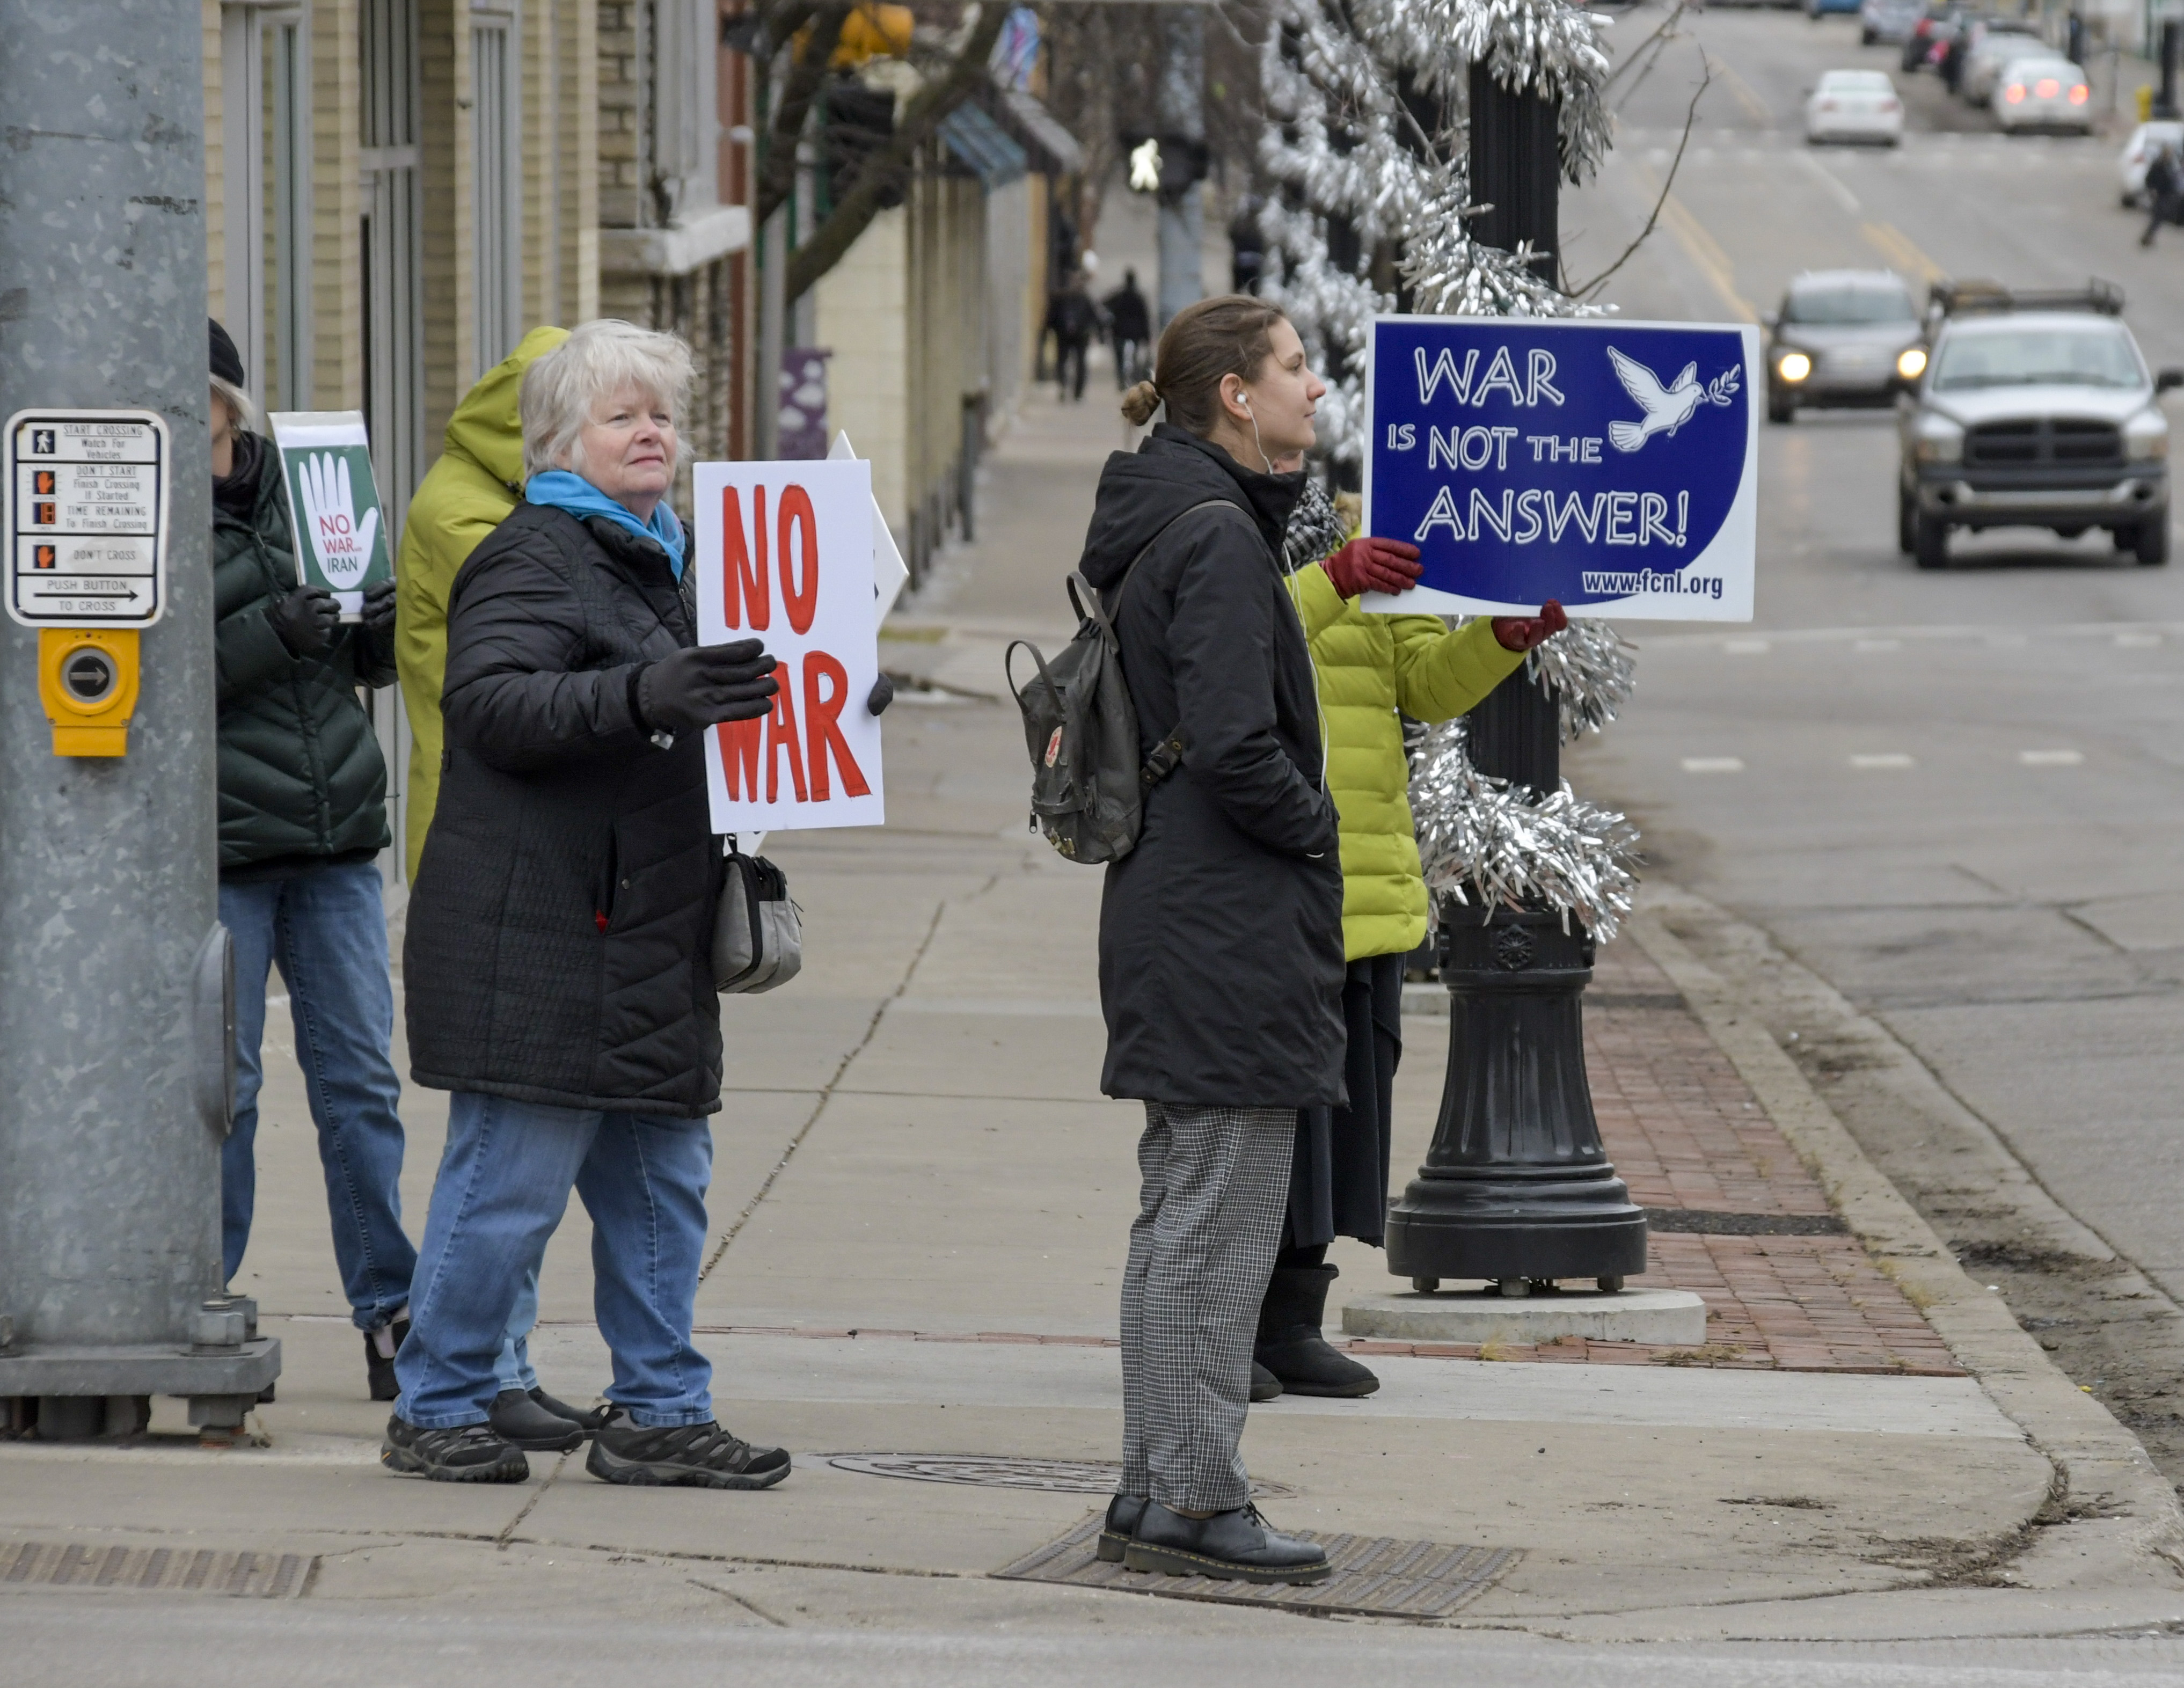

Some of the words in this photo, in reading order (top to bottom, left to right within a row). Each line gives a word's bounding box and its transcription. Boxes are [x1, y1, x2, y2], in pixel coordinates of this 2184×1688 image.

[1414, 345, 1565, 407] WAR
[63, 425, 91, 434] START
[97, 425, 142, 435] CROSSING
[82, 438, 106, 447] Watch
[112, 438, 125, 448] For
[1387, 423, 1416, 450] IS
[1428, 426, 1518, 470] NOT
[1526, 435, 1603, 463] THE
[86, 450, 121, 459] Vehicles
[109, 466, 136, 475] START
[74, 479, 98, 488] Finish
[105, 479, 140, 491] Crossing
[97, 491, 128, 500] Started
[67, 506, 87, 515] TIME
[96, 506, 147, 516] REMAINING
[1414, 485, 1689, 547] ANSWER!
[66, 518, 76, 528] To
[82, 518, 107, 528] Finish
[113, 518, 147, 531] Crossing
[319, 514, 350, 536] NO
[322, 537, 354, 554] WAR
[74, 550, 101, 560] DON'T
[107, 550, 136, 560] CROSS
[722, 482, 818, 634] NO
[327, 556, 358, 573] IRAN
[47, 580, 77, 590] PUSH
[83, 580, 127, 590] BUTTON
[1582, 568, 1722, 599] www.fcnl.org
[59, 601, 72, 611] TO
[78, 601, 116, 611] CROSS
[717, 650, 872, 803] WAR
